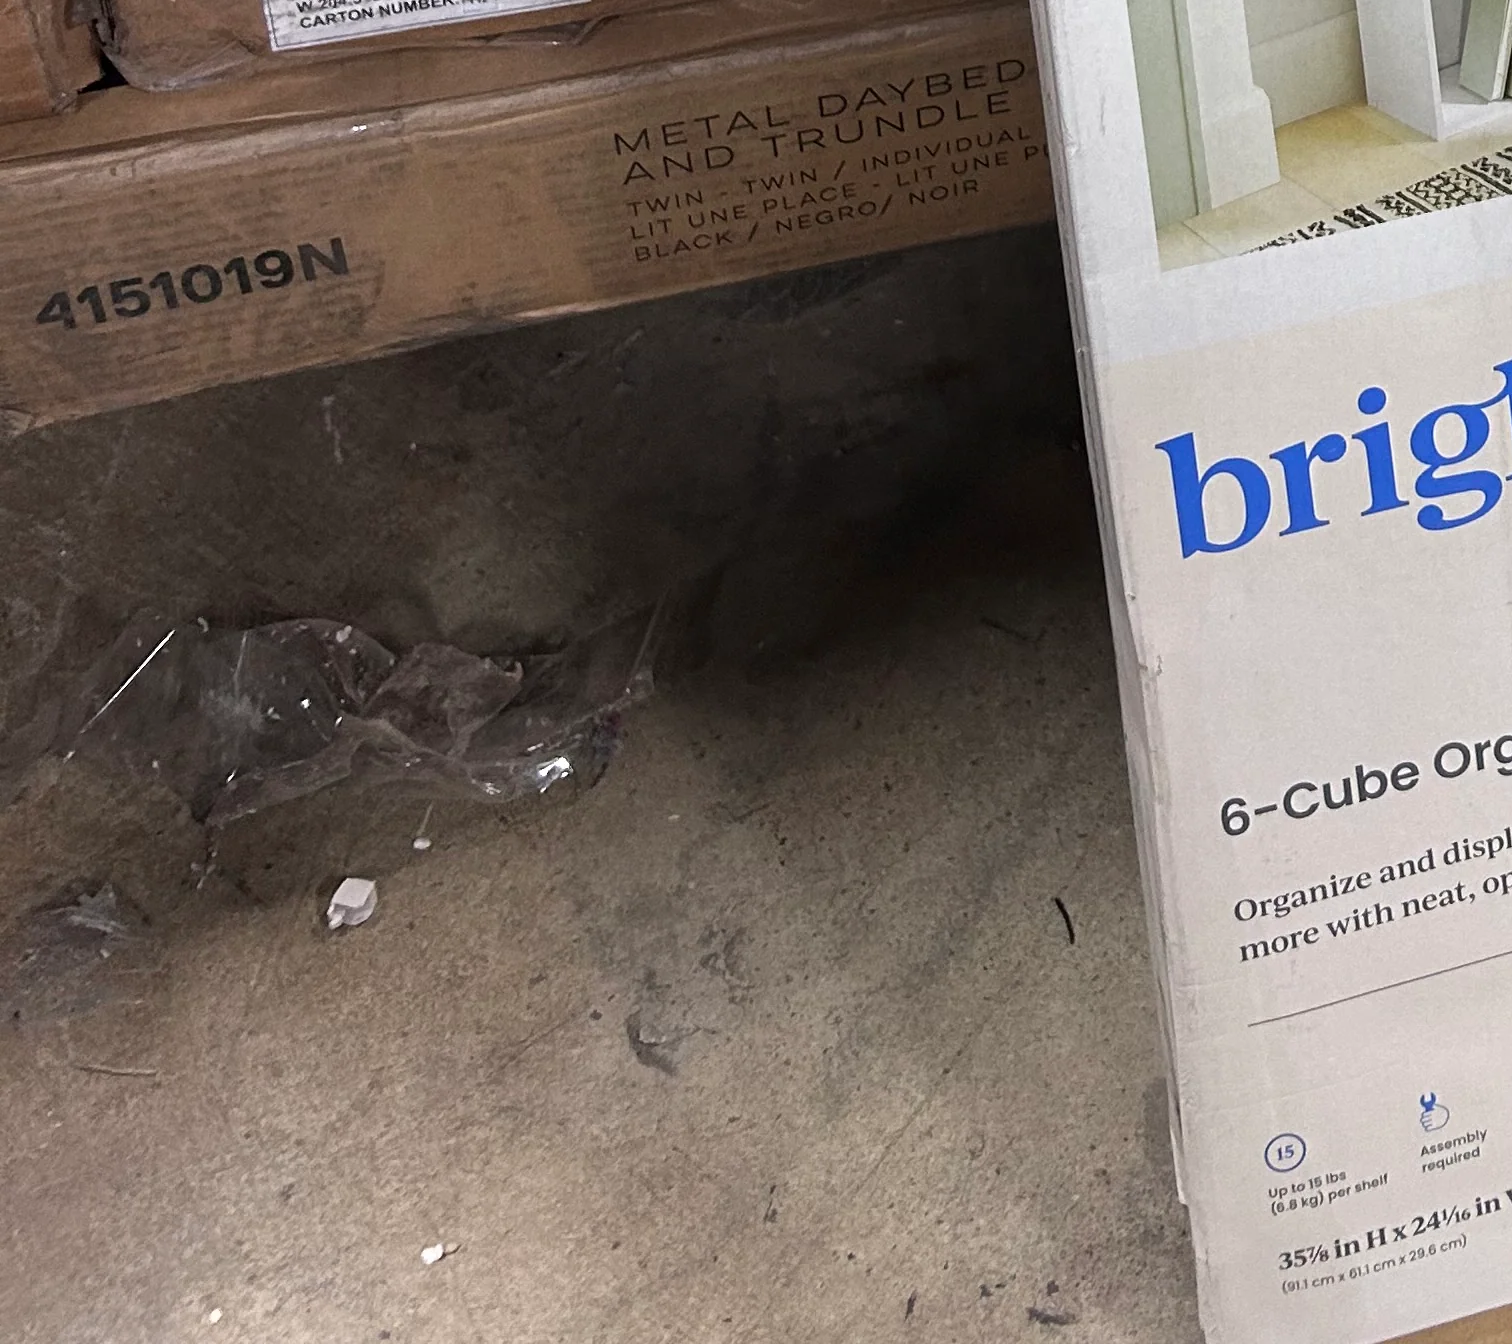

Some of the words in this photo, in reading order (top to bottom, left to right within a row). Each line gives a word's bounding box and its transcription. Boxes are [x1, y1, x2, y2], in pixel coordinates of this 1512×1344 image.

[296, 0, 313, 13] W
[299, 7, 374, 29] CARTON
[614, 105, 790, 156] METAL
[818, 59, 1025, 118] DAYBED
[624, 145, 735, 185] AND
[760, 90, 1011, 158] TRUNDLE
[627, 190, 704, 217] TWIN
[743, 167, 818, 194] TWIN
[862, 126, 1031, 173] INDIVIDUAL
[631, 217, 672, 240] LIT
[688, 203, 749, 229] UNE
[762, 182, 857, 214] PLACE
[896, 164, 937, 187] LIT
[952, 150, 1009, 175] UNE
[634, 232, 733, 262] BLACK
[909, 179, 979, 205] NOIR
[36, 237, 349, 329] 4151019N
[1219, 759, 1420, 837] 6-Cube
[1233, 865, 1373, 924] Organize
[1379, 848, 1437, 886] and
[1239, 925, 1320, 963] more
[1326, 900, 1395, 939] with
[1402, 879, 1477, 920] neat,
[1420, 1129, 1488, 1157] Assembly
[1421, 1146, 1481, 1174] required
[1268, 1184, 1288, 1201] Up
[1291, 1180, 1306, 1195] to
[1308, 1175, 1322, 1190] 15
[1326, 1169, 1347, 1185] lbs
[1300, 1191, 1324, 1209] kg)
[1328, 1187, 1351, 1204] per
[1355, 1173, 1389, 1194] shelf
[1311, 1272, 1336, 1288] cm
[1373, 1259, 1397, 1275] cm
[1409, 1243, 1437, 1264] 29.6
[1440, 1233, 1468, 1255] cm)
[1334, 1238, 1360, 1260] in
[1366, 1230, 1388, 1252] H
[1393, 1227, 1408, 1242] x
[1475, 1196, 1501, 1218] in
